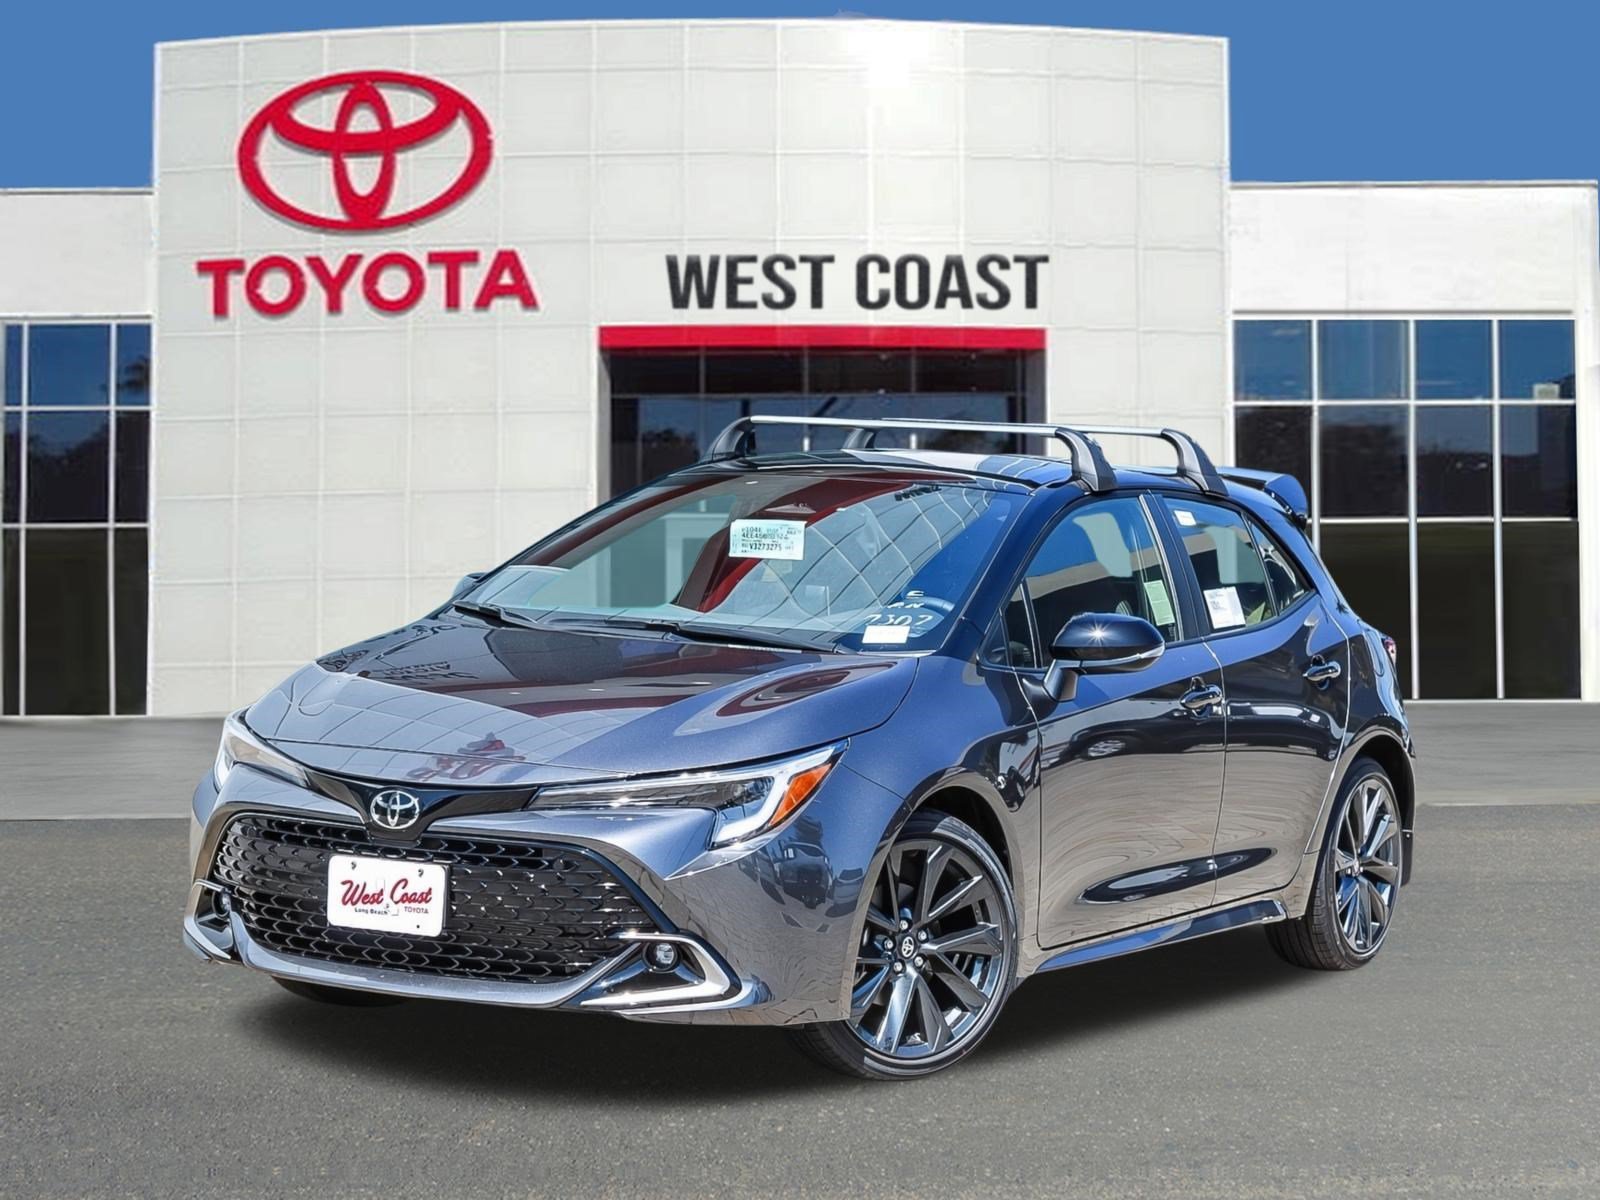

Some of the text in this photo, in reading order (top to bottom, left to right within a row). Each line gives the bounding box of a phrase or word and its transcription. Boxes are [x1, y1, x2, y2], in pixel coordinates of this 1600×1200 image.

[196, 250, 539, 318] TOYOTA
[666, 254, 1049, 310] WEST COAST
[340, 878, 432, 906] West Coast
[370, 908, 388, 916] Beach
[404, 906, 429, 914] TOYOTA
